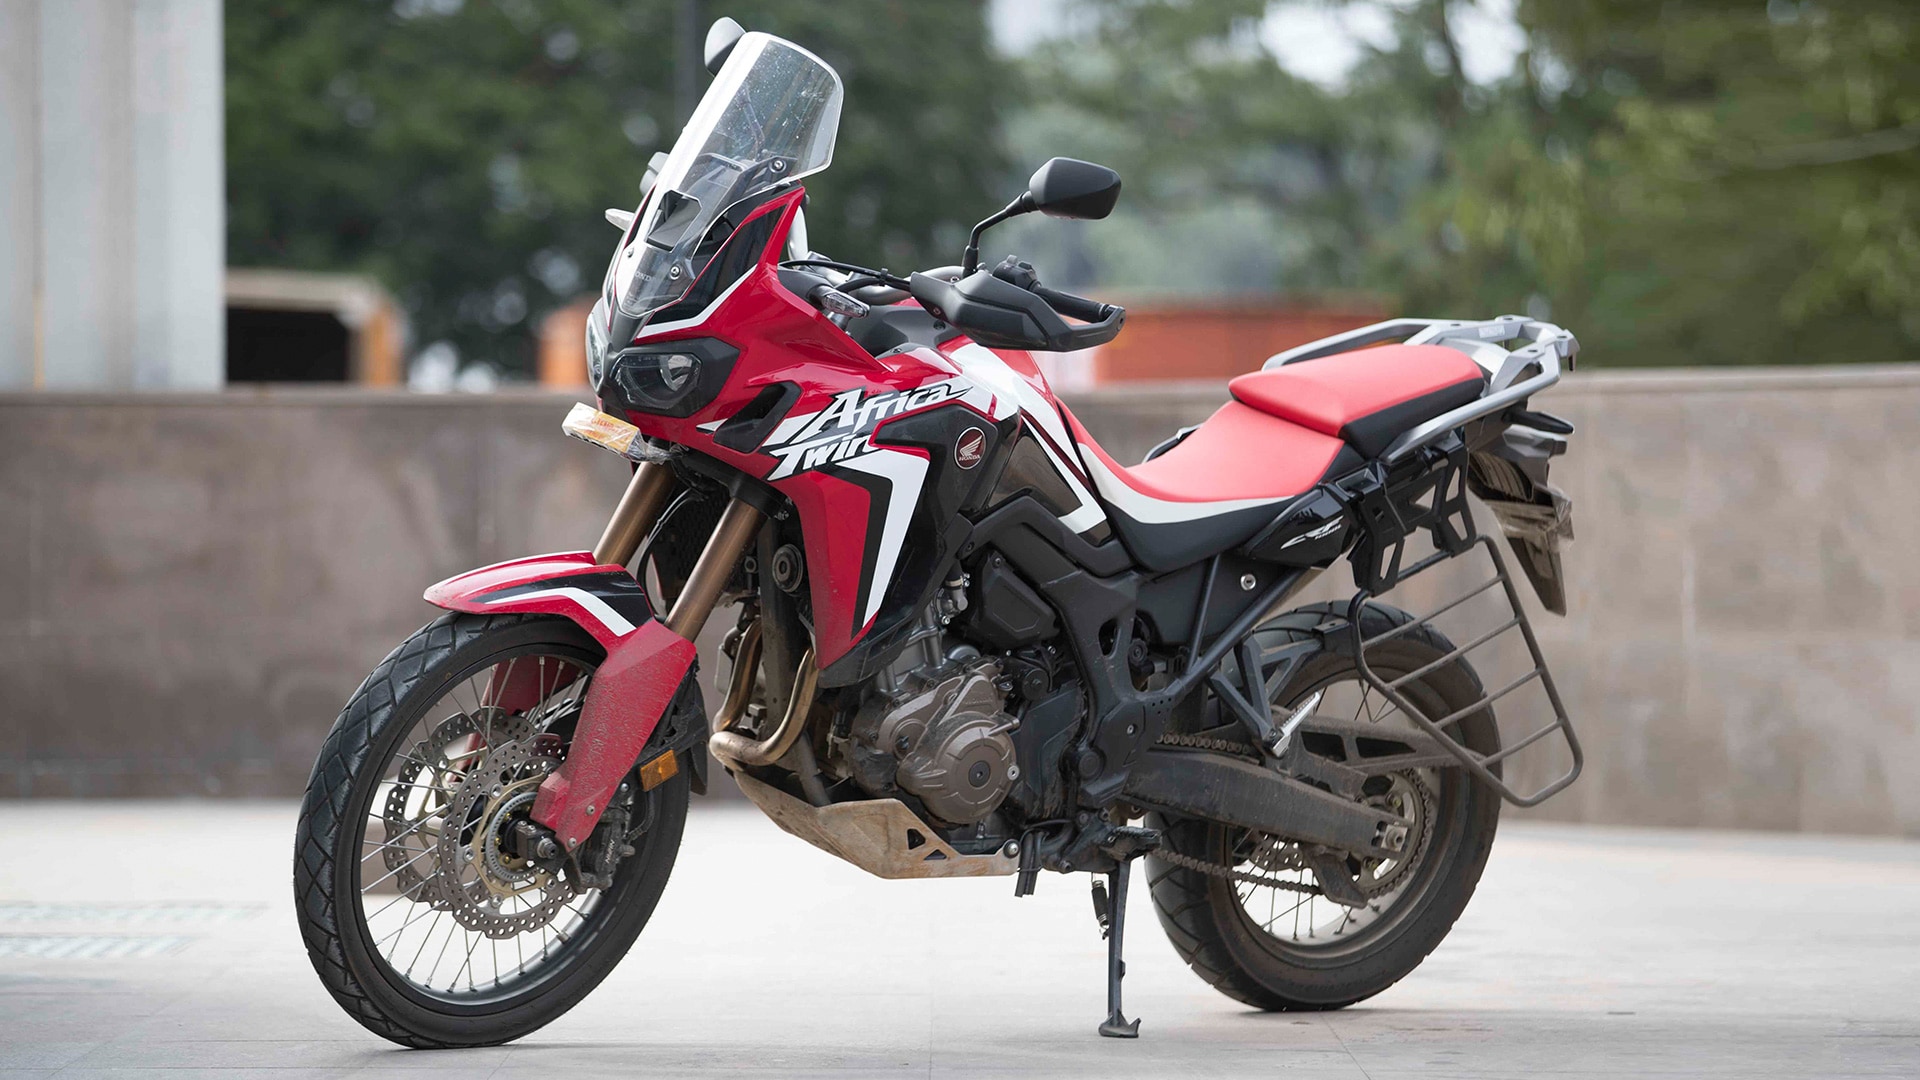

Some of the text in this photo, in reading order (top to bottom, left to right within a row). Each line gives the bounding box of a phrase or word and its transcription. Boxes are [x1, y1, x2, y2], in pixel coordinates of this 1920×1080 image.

[789, 384, 973, 444] Africa
[767, 431, 880, 481] Twin
[958, 454, 980, 462] HONDA
